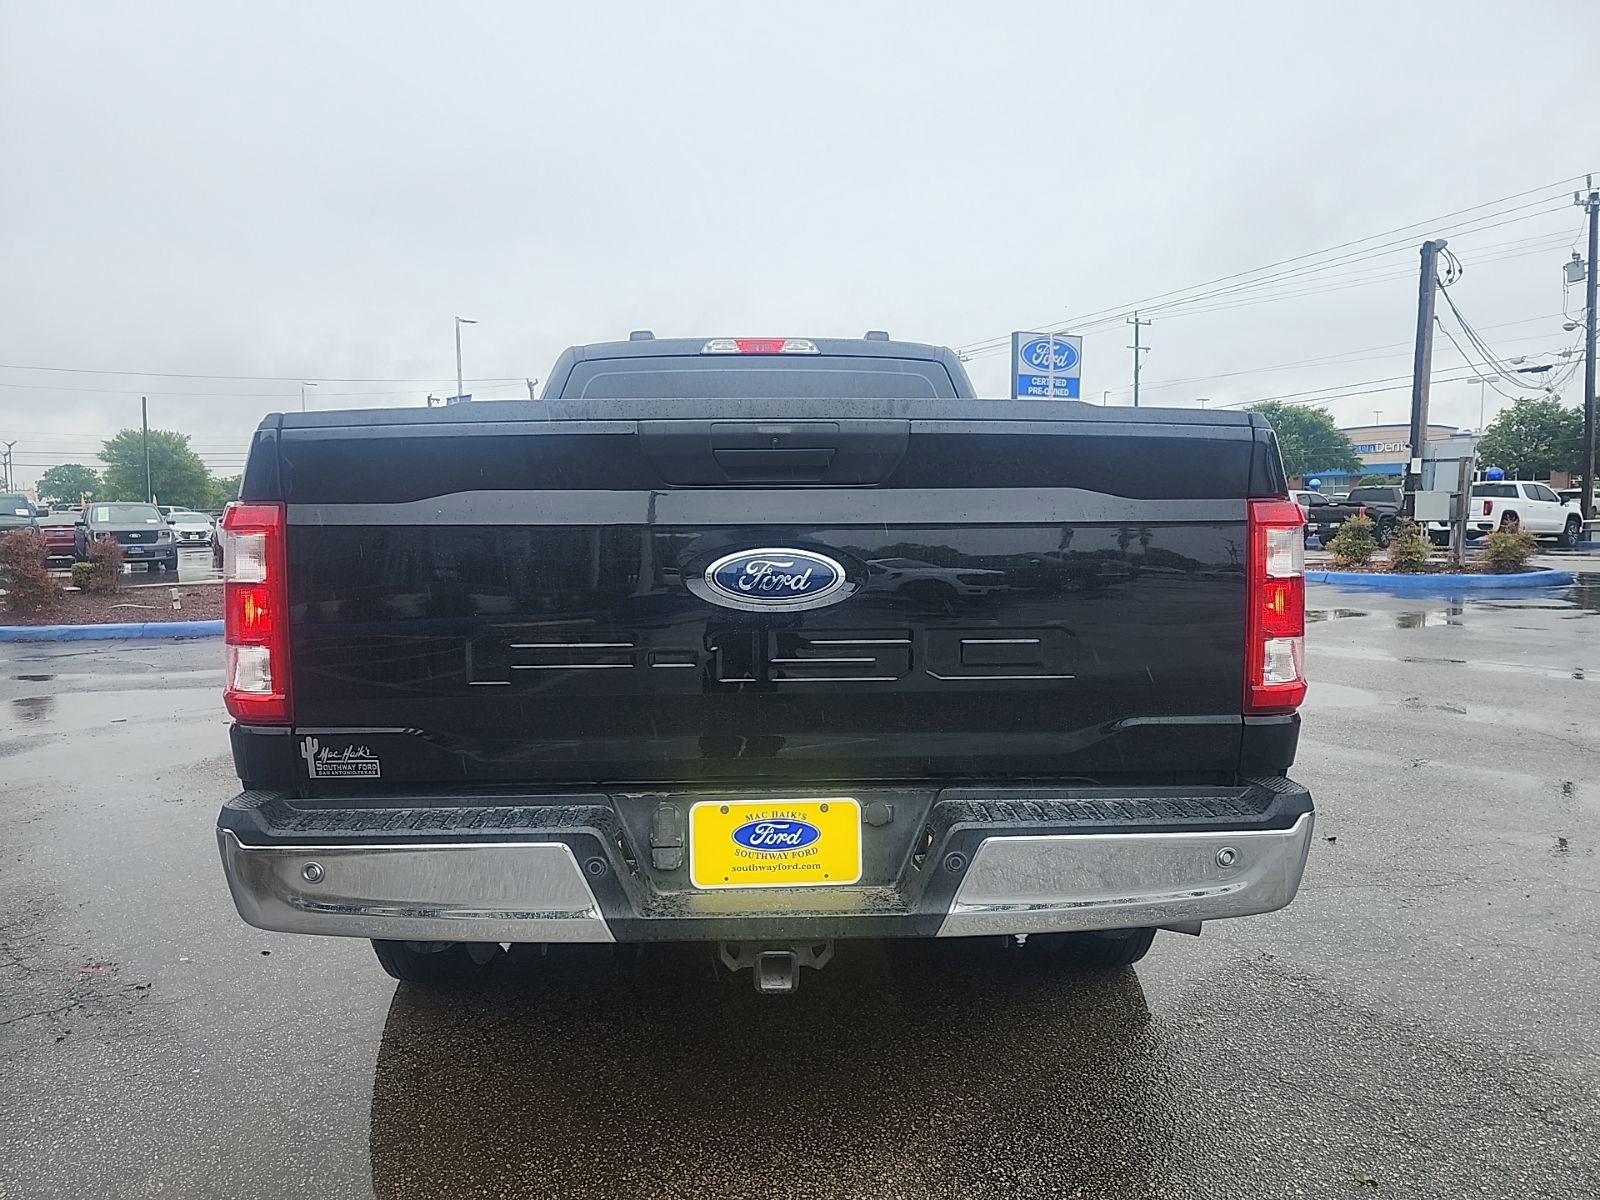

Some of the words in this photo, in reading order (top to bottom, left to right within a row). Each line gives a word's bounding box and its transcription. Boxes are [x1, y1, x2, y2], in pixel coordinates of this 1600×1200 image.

[1031, 377, 1067, 387] CERTFIED
[738, 560, 813, 591] Ford
[318, 746, 342, 763] Mac
[357, 763, 377, 771] FORD
[745, 811, 769, 822] MAC
[771, 810, 808, 821] HAIK'S
[749, 823, 803, 845] Ford
[734, 848, 789, 860] SOUTHWAY
[792, 847, 819, 860] FORD
[731, 862, 821, 873] southwayford.com
